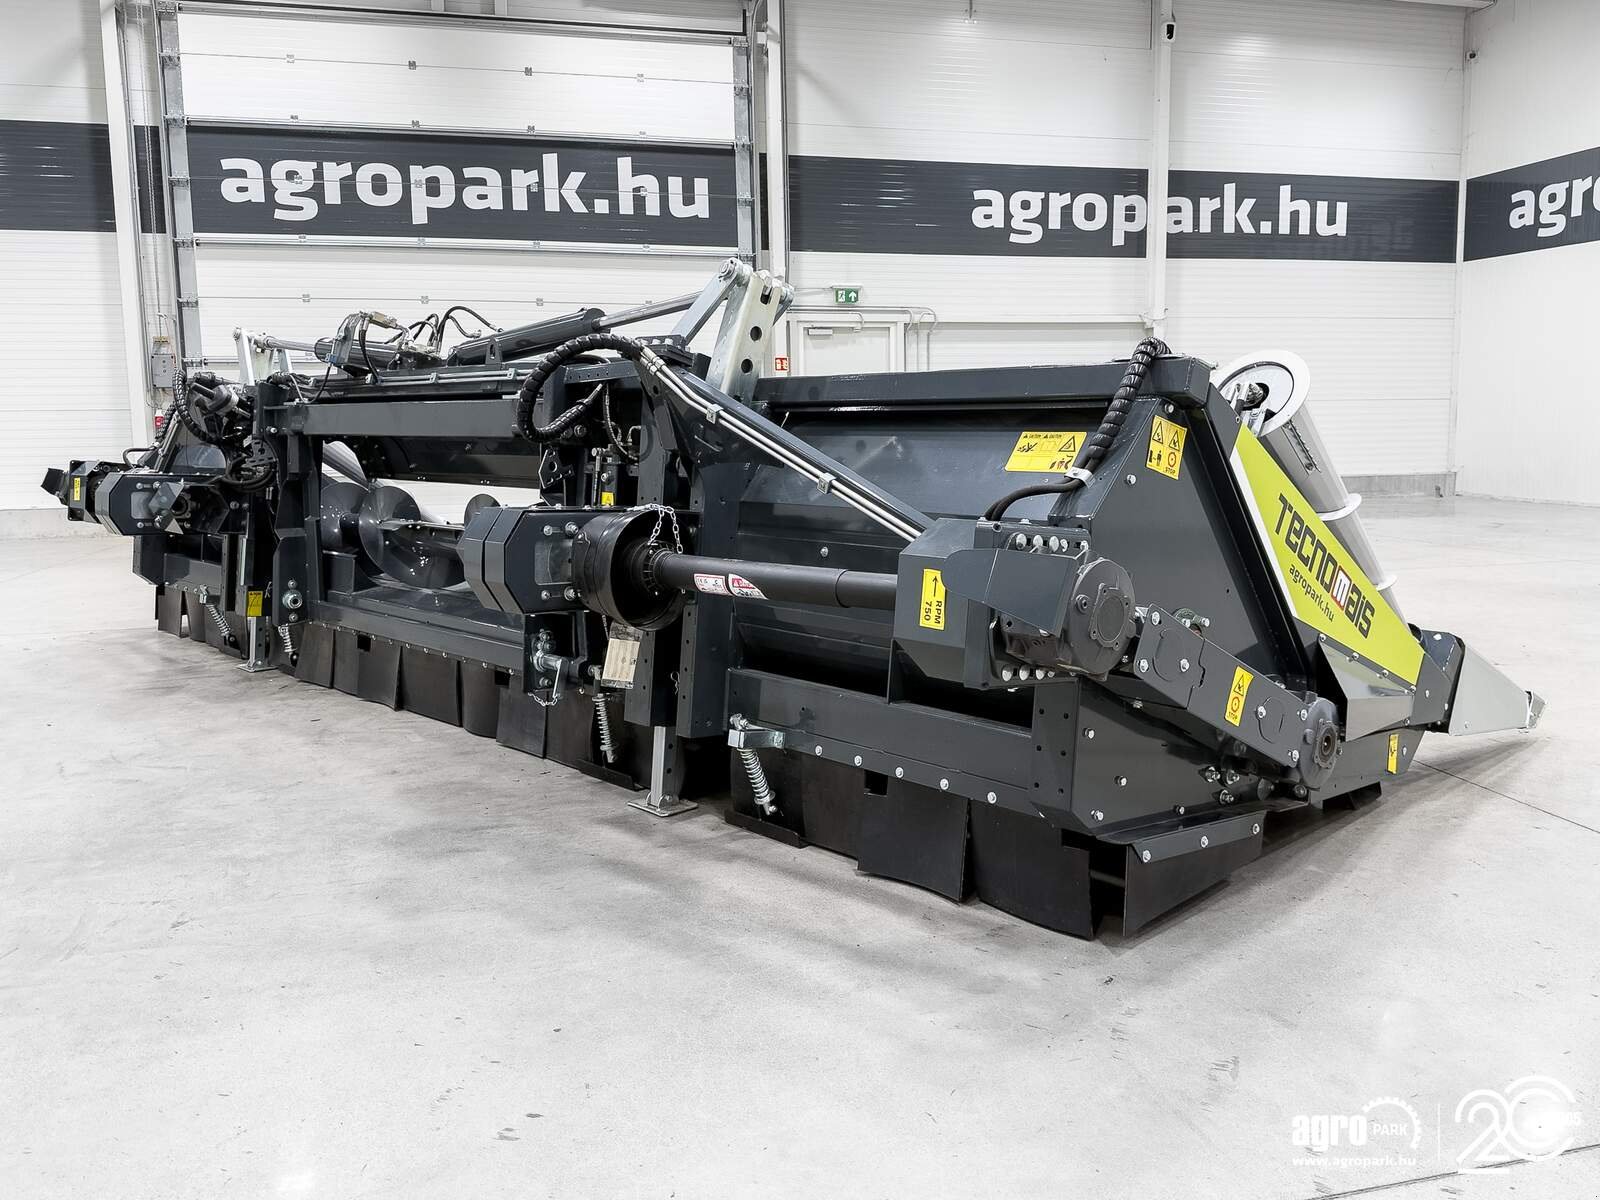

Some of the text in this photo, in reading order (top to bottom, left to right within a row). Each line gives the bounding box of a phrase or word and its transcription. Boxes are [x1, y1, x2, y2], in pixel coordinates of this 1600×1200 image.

[220, 153, 710, 224] agropark.hu
[971, 182, 1348, 246] agropark.hu
[1509, 176, 1600, 237] agr
[924, 601, 933, 621] 750
[934, 600, 943, 624] RPM
[1289, 564, 1335, 622] agropark.hu
